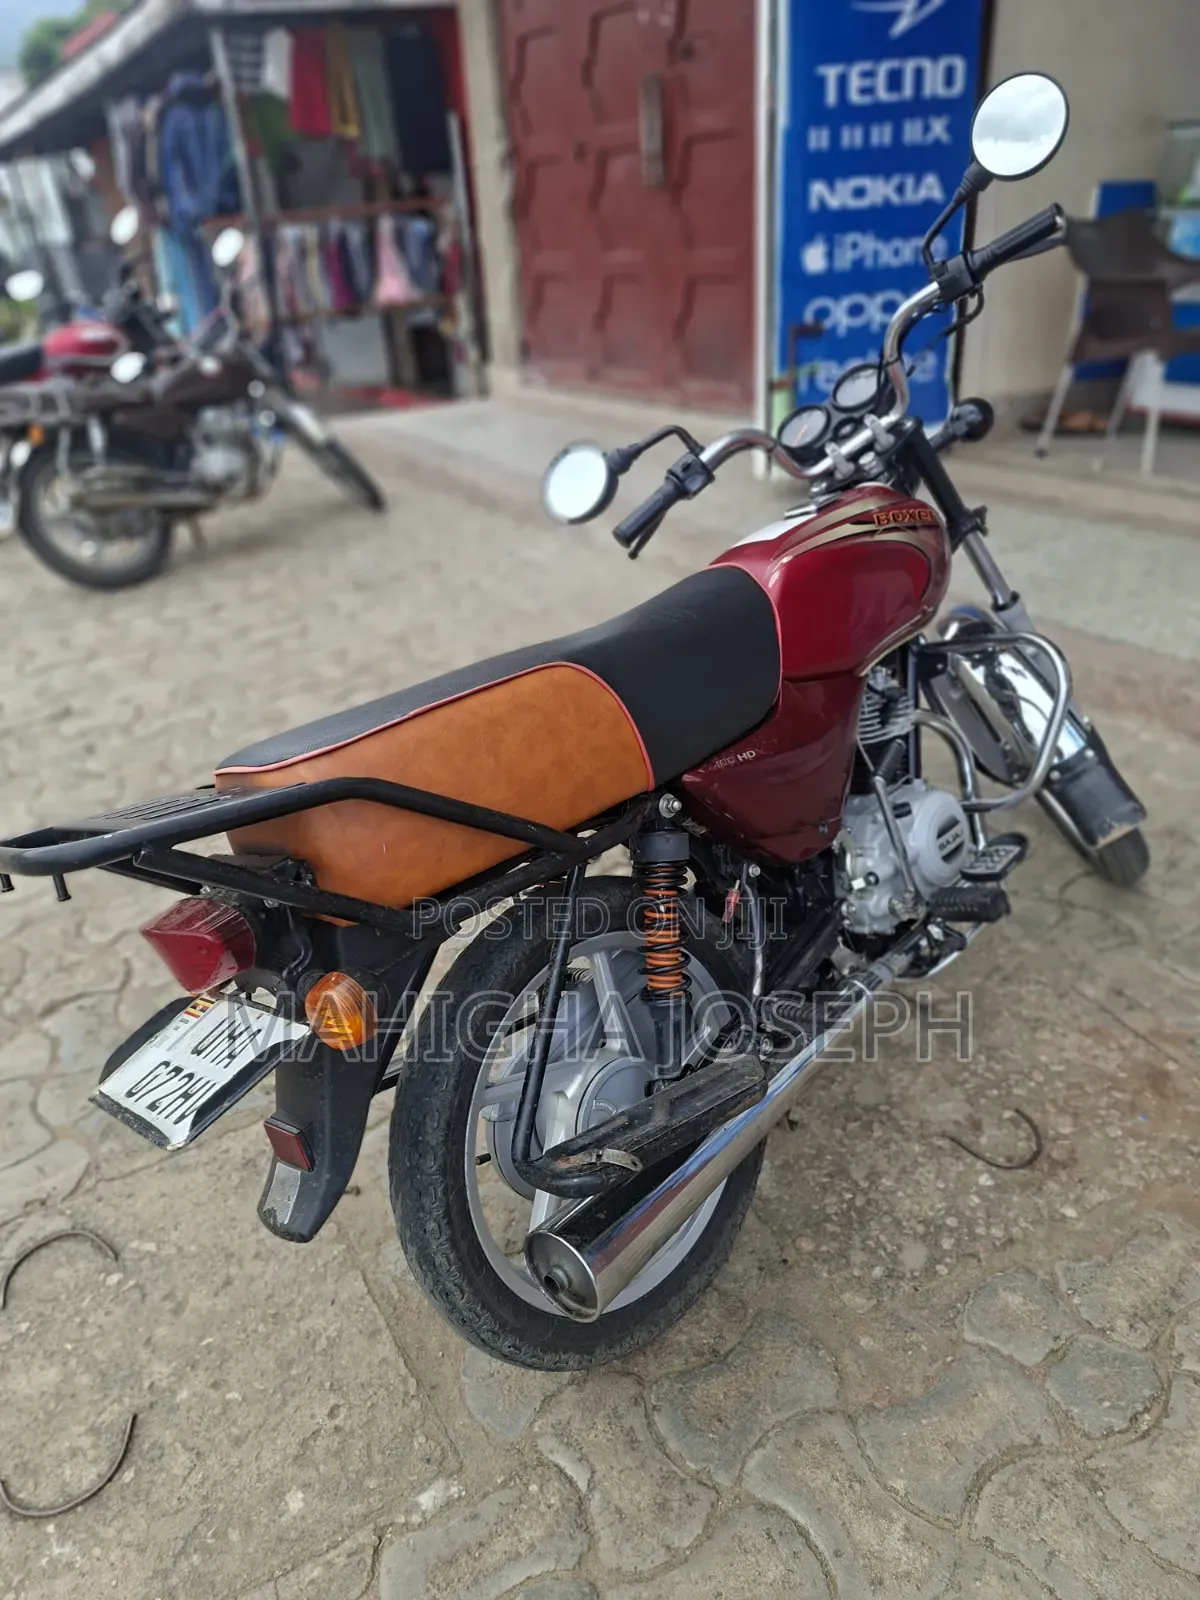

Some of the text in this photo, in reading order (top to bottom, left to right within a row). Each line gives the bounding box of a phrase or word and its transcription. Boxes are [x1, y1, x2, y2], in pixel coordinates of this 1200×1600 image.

[814, 54, 968, 108] TECNO
[808, 171, 945, 212] NOKIA
[803, 289, 912, 337] opp
[736, 750, 756, 762] HD
[191, 1016, 262, 1068] UMA
